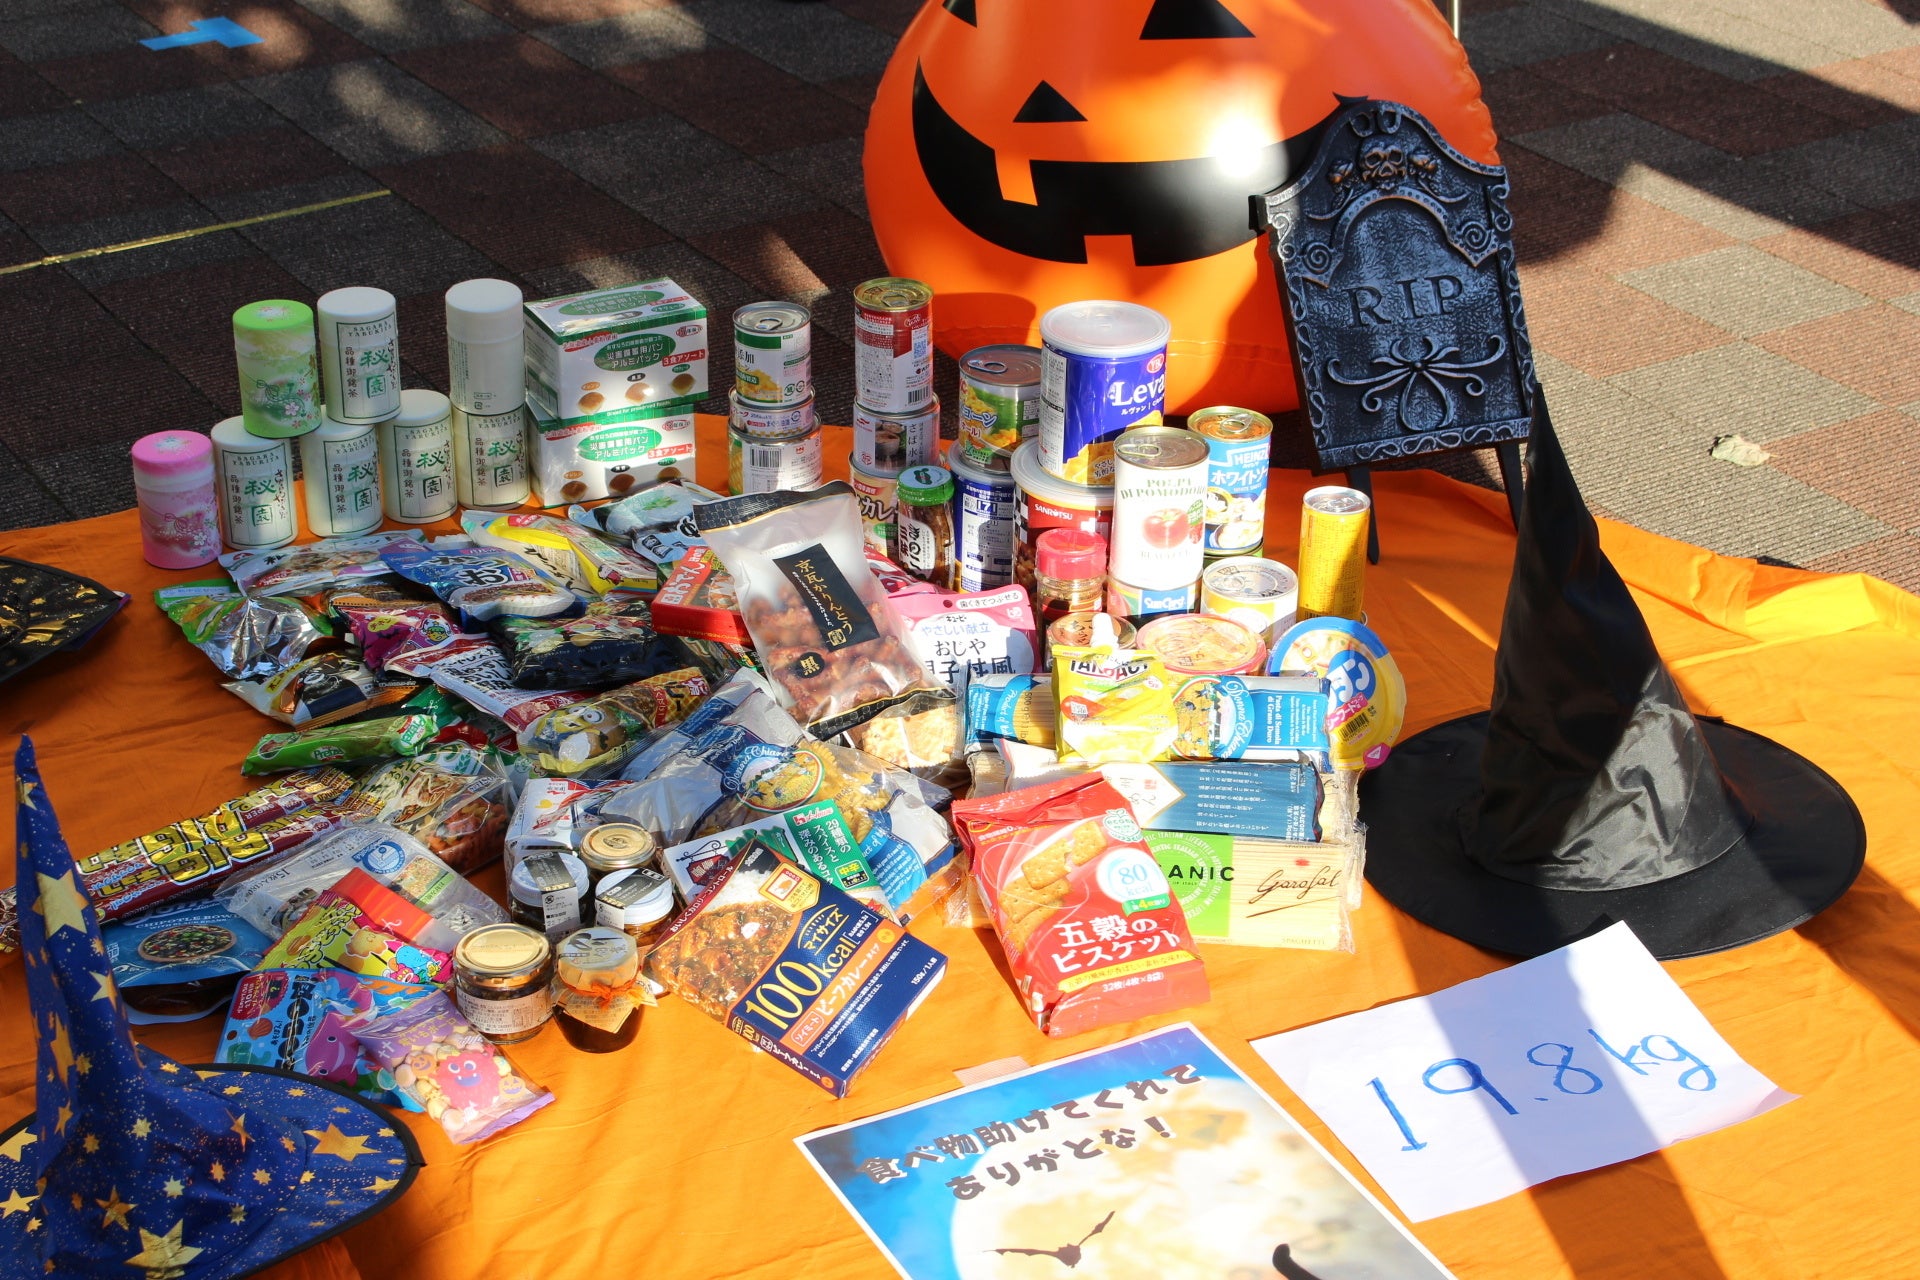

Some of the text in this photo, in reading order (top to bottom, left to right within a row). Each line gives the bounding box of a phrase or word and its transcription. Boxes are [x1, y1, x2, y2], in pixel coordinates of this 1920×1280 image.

[1342, 274, 1465, 328] RIP
[612, 352, 660, 369] アルミパック
[1121, 404, 1147, 416] ルヴァン
[230, 474, 243, 525] 品種御銘茶
[921, 622, 992, 637] やさしい献立
[934, 638, 986, 657] おじや
[800, 657, 821, 676] 黒
[1000, 689, 1018, 716] Product
[1221, 681, 1250, 721] Donna
[1266, 704, 1274, 724] Grano
[1274, 695, 1283, 713] Pasta
[1266, 726, 1274, 743] Duro
[1274, 721, 1283, 745] Semola
[720, 753, 750, 791] Donna
[814, 824, 840, 863] スパイスと
[825, 818, 852, 854] 29種類の
[163, 831, 273, 886] BIG
[838, 862, 863, 876] 中辛
[1118, 863, 1149, 886] 80
[1168, 864, 1235, 882] ANIC
[670, 865, 734, 933] おいしくカロリーコントロール
[136, 915, 201, 929] CHIPOTLE
[803, 908, 845, 950] マイサイズ
[1053, 916, 1159, 949] 五穀の
[1052, 932, 1181, 974] ビスケット
[746, 935, 858, 1031] 100kcal
[795, 1014, 821, 1041] ソイミート
[816, 957, 869, 1017] ビーフカレー
[1366, 1029, 1717, 1151] 19.8kg
[855, 1063, 1206, 1184] 食べ物助けてくれて
[945, 1115, 1174, 1201] ありがとな！
